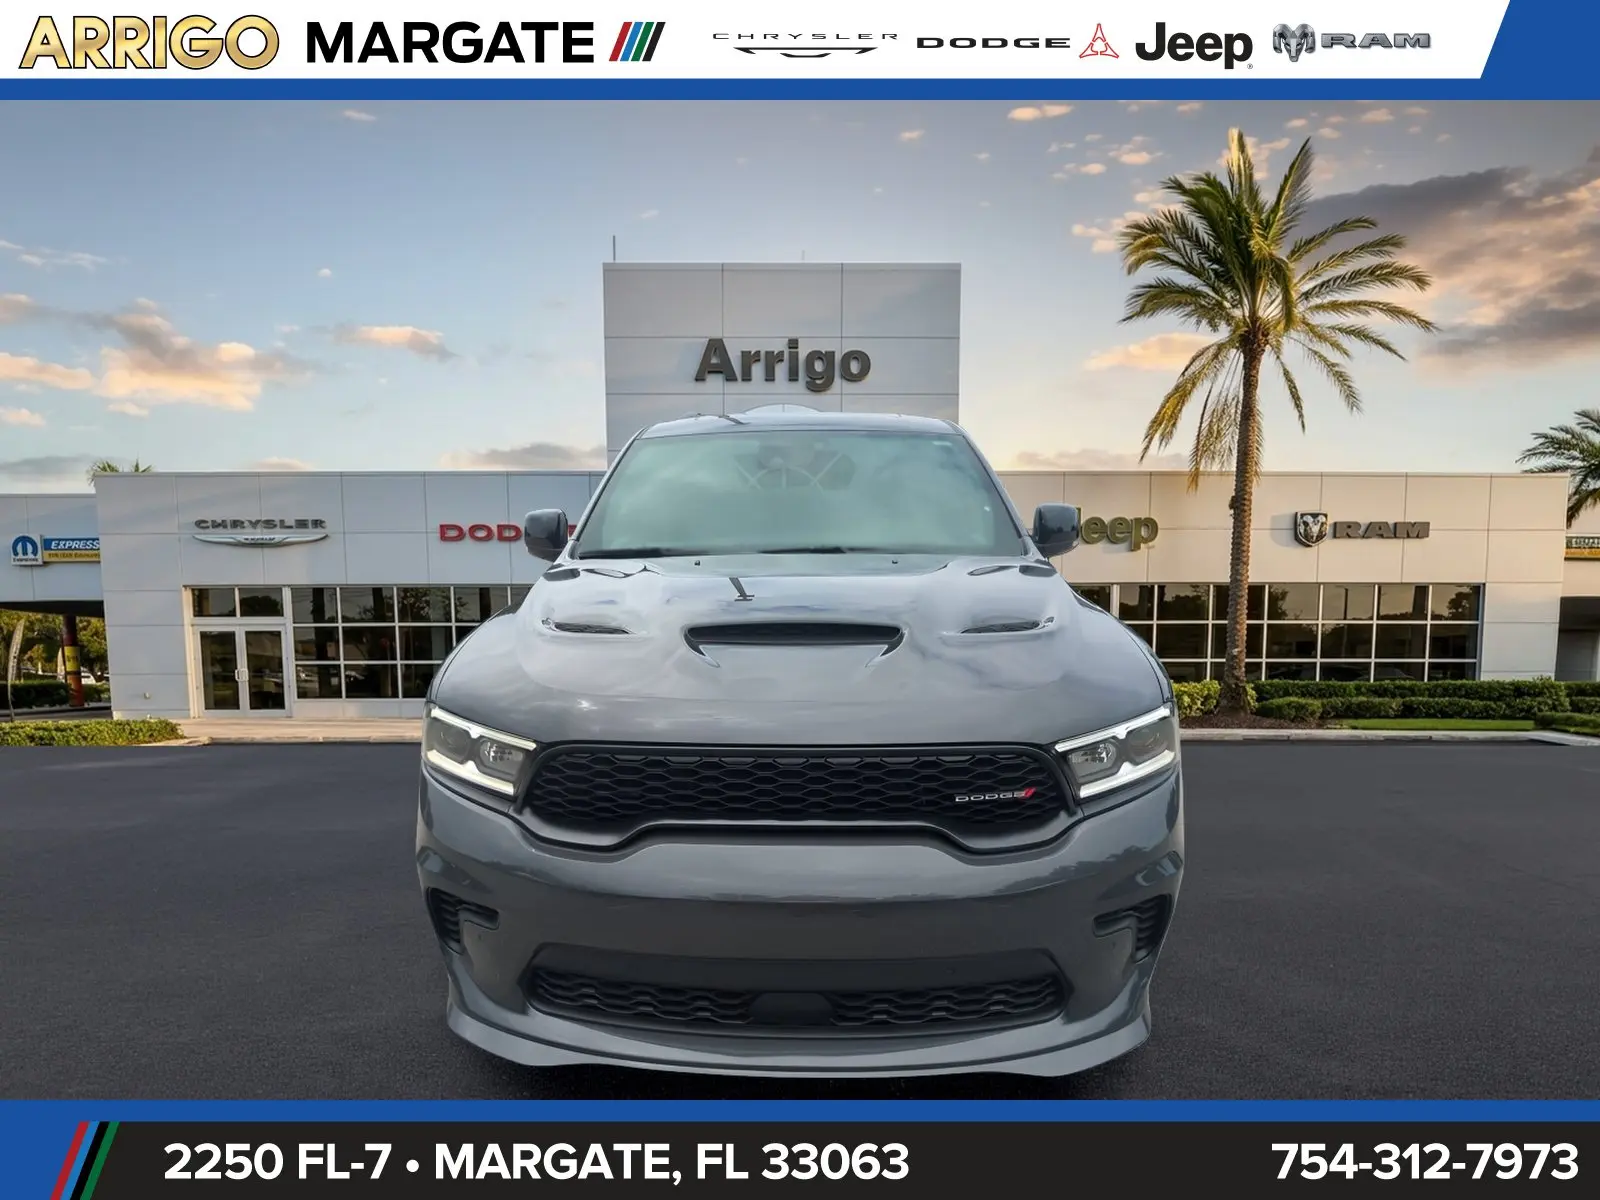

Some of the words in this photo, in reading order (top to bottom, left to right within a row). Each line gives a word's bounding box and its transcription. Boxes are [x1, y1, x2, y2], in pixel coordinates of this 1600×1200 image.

[694, 337, 871, 393] Arrigo
[194, 518, 327, 529] CHRYSLER
[1334, 521, 1430, 539] RAM
[439, 524, 577, 541] DOD
[51, 540, 100, 549] EXPRESS
[955, 790, 1025, 802] DODGE
